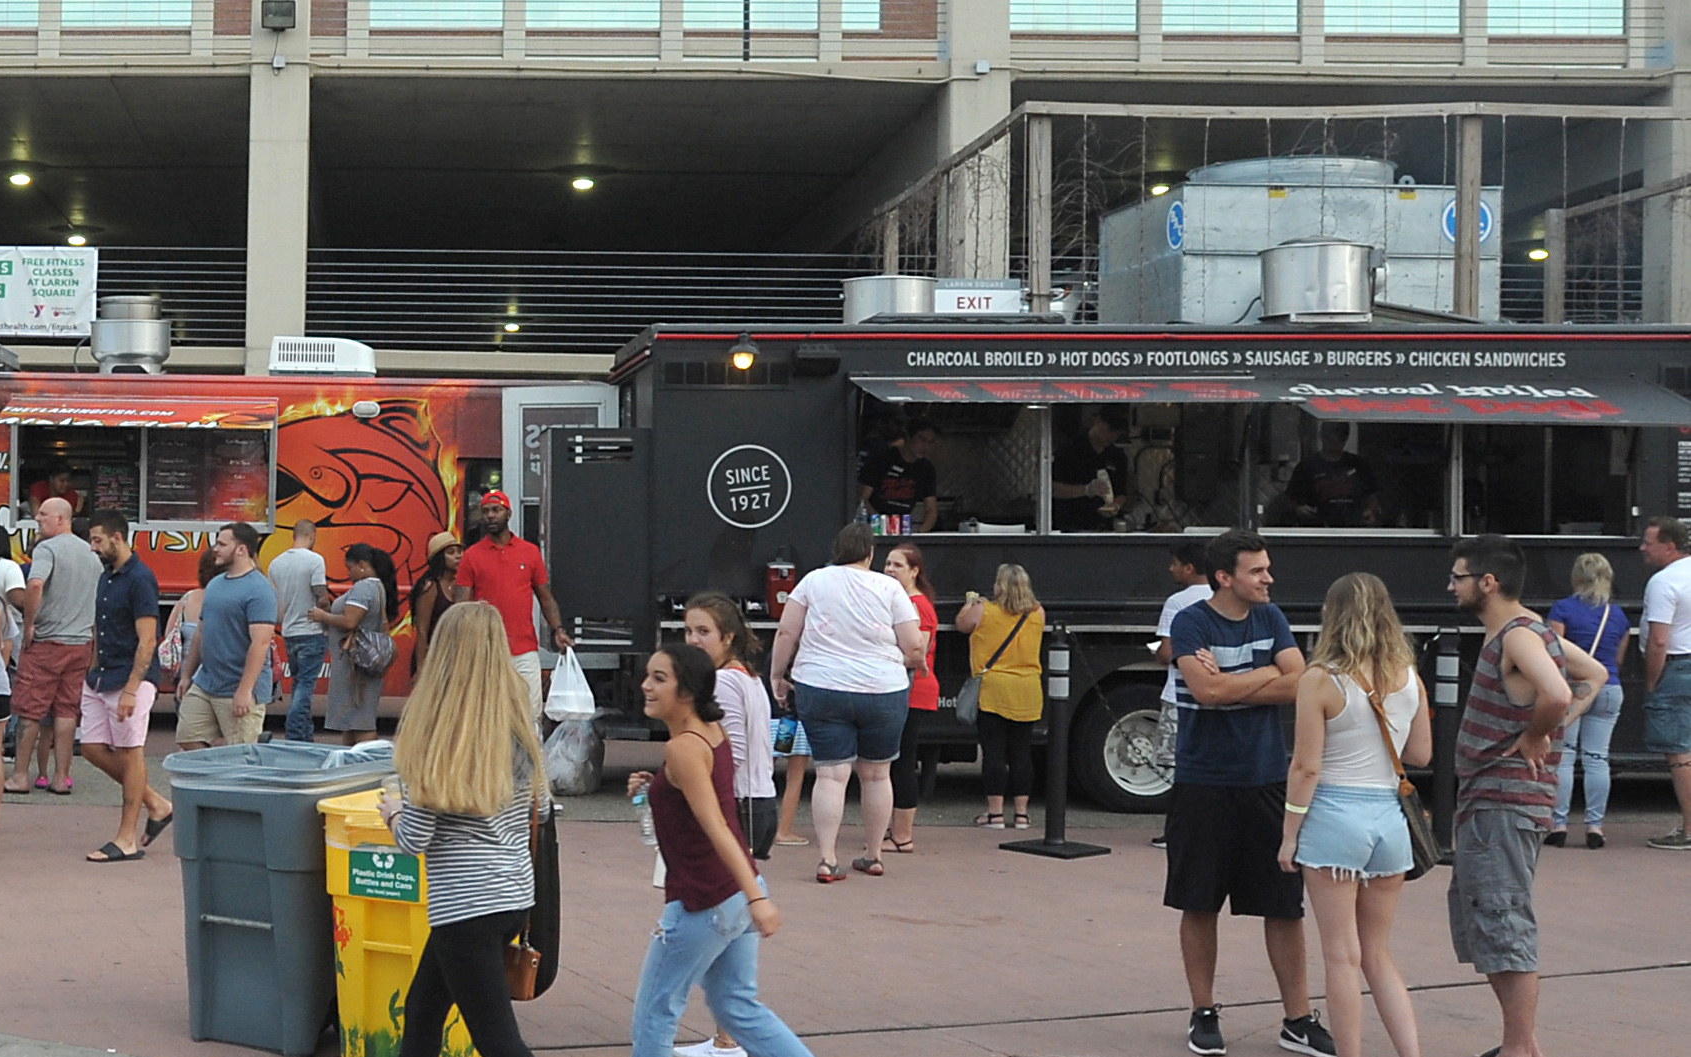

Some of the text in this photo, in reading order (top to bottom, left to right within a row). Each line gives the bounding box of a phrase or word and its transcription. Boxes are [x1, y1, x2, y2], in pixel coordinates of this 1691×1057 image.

[22, 257, 85, 267] FREE FITNESS
[32, 268, 74, 276] CLASSES
[27, 278, 79, 287] AT LARKIN
[32, 288, 76, 298] SQUARE!
[957, 296, 992, 309] EXIT
[907, 351, 1566, 367] CHARCOAL BROILED HOT DOGS FOOTLONGS SAUSAGE BURGERS CHICKEN SANDWICHES
[725, 465, 771, 485] SINCE
[730, 492, 771, 512] 1927
[938, 696, 957, 708] Hot
[352, 867, 416, 883] Plastic Drink Cups,
[355, 876, 413, 890] Bottles and Cans
